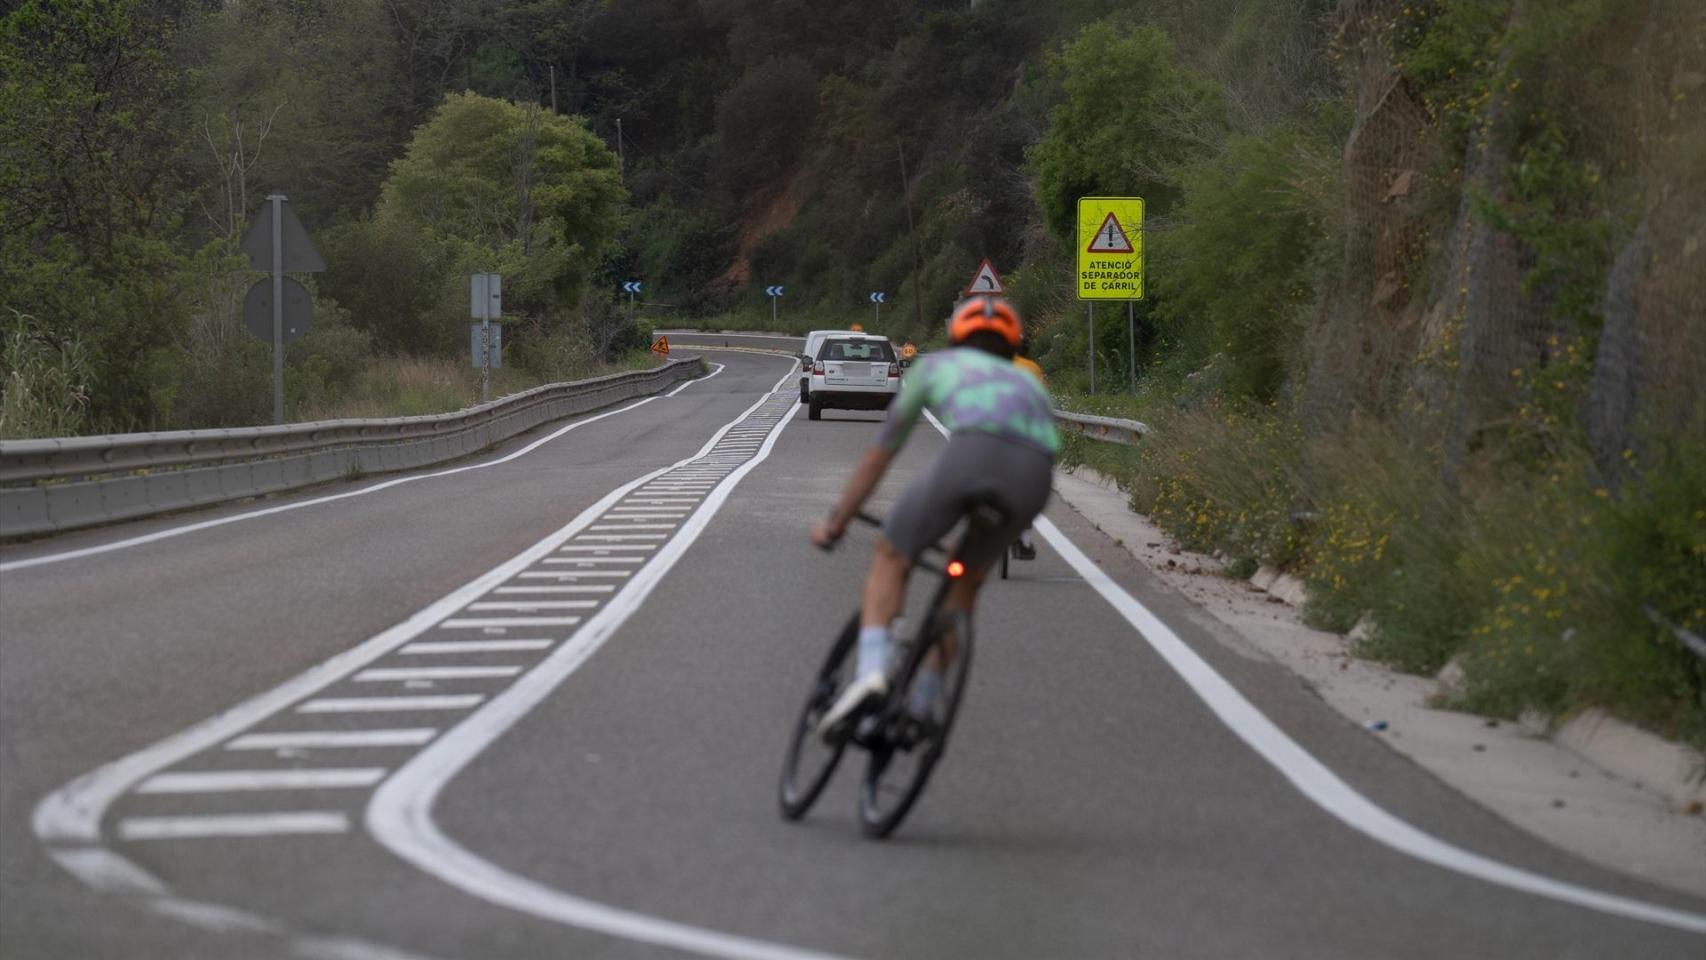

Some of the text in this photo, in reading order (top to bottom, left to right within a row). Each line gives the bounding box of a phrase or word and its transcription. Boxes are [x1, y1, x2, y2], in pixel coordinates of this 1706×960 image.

[1081, 271, 1140, 279] SEPARADOR
[1084, 281, 1136, 290] DE CARRIL
